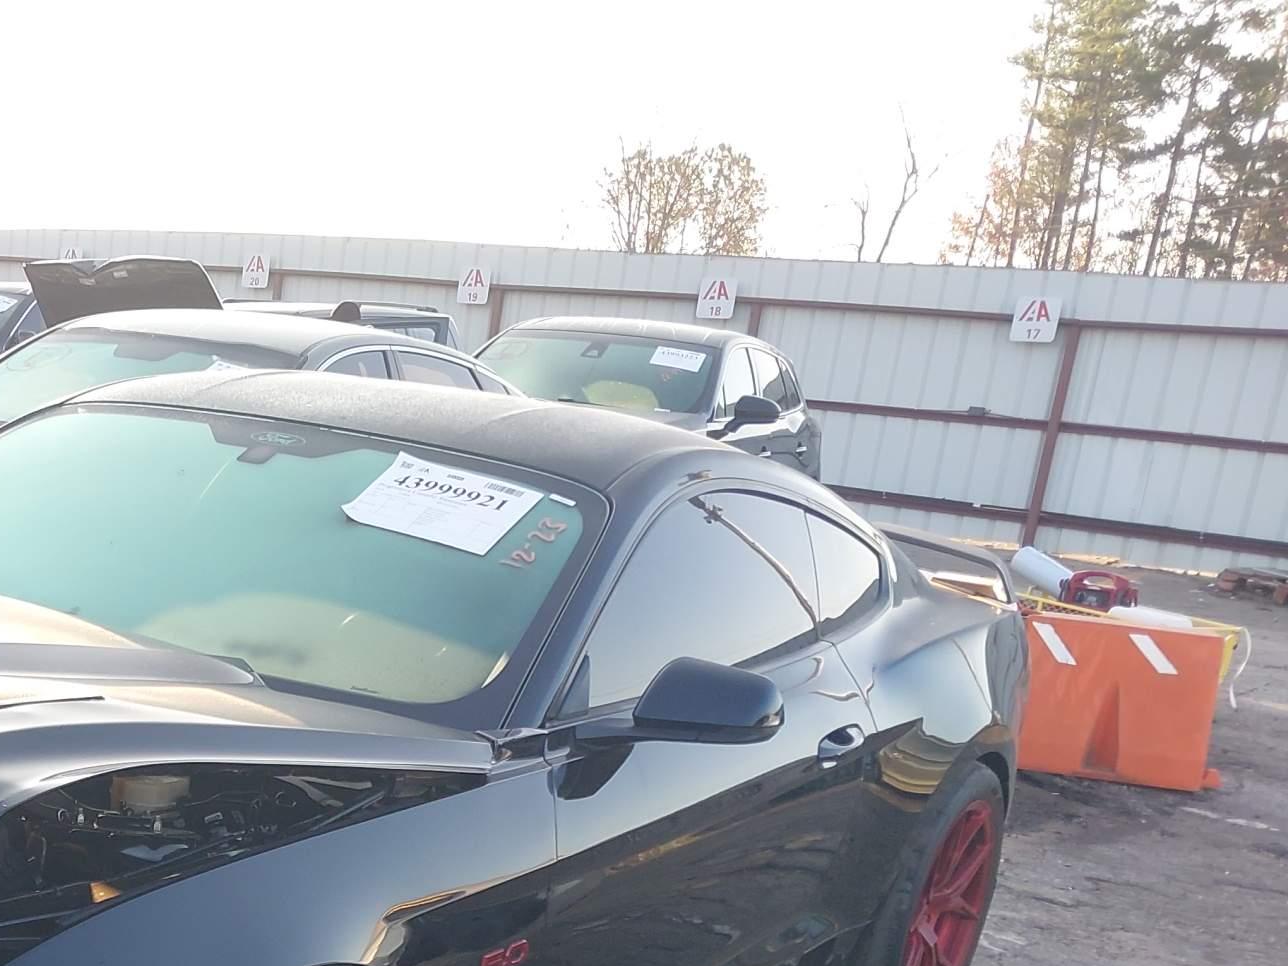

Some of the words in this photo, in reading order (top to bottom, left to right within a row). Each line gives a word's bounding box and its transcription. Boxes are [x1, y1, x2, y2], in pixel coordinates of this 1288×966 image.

[250, 276, 260, 286] 20
[468, 292, 478, 302] 19
[710, 306, 722, 316] 18
[1027, 329, 1041, 340] 17
[393, 475, 509, 511] 43999921
